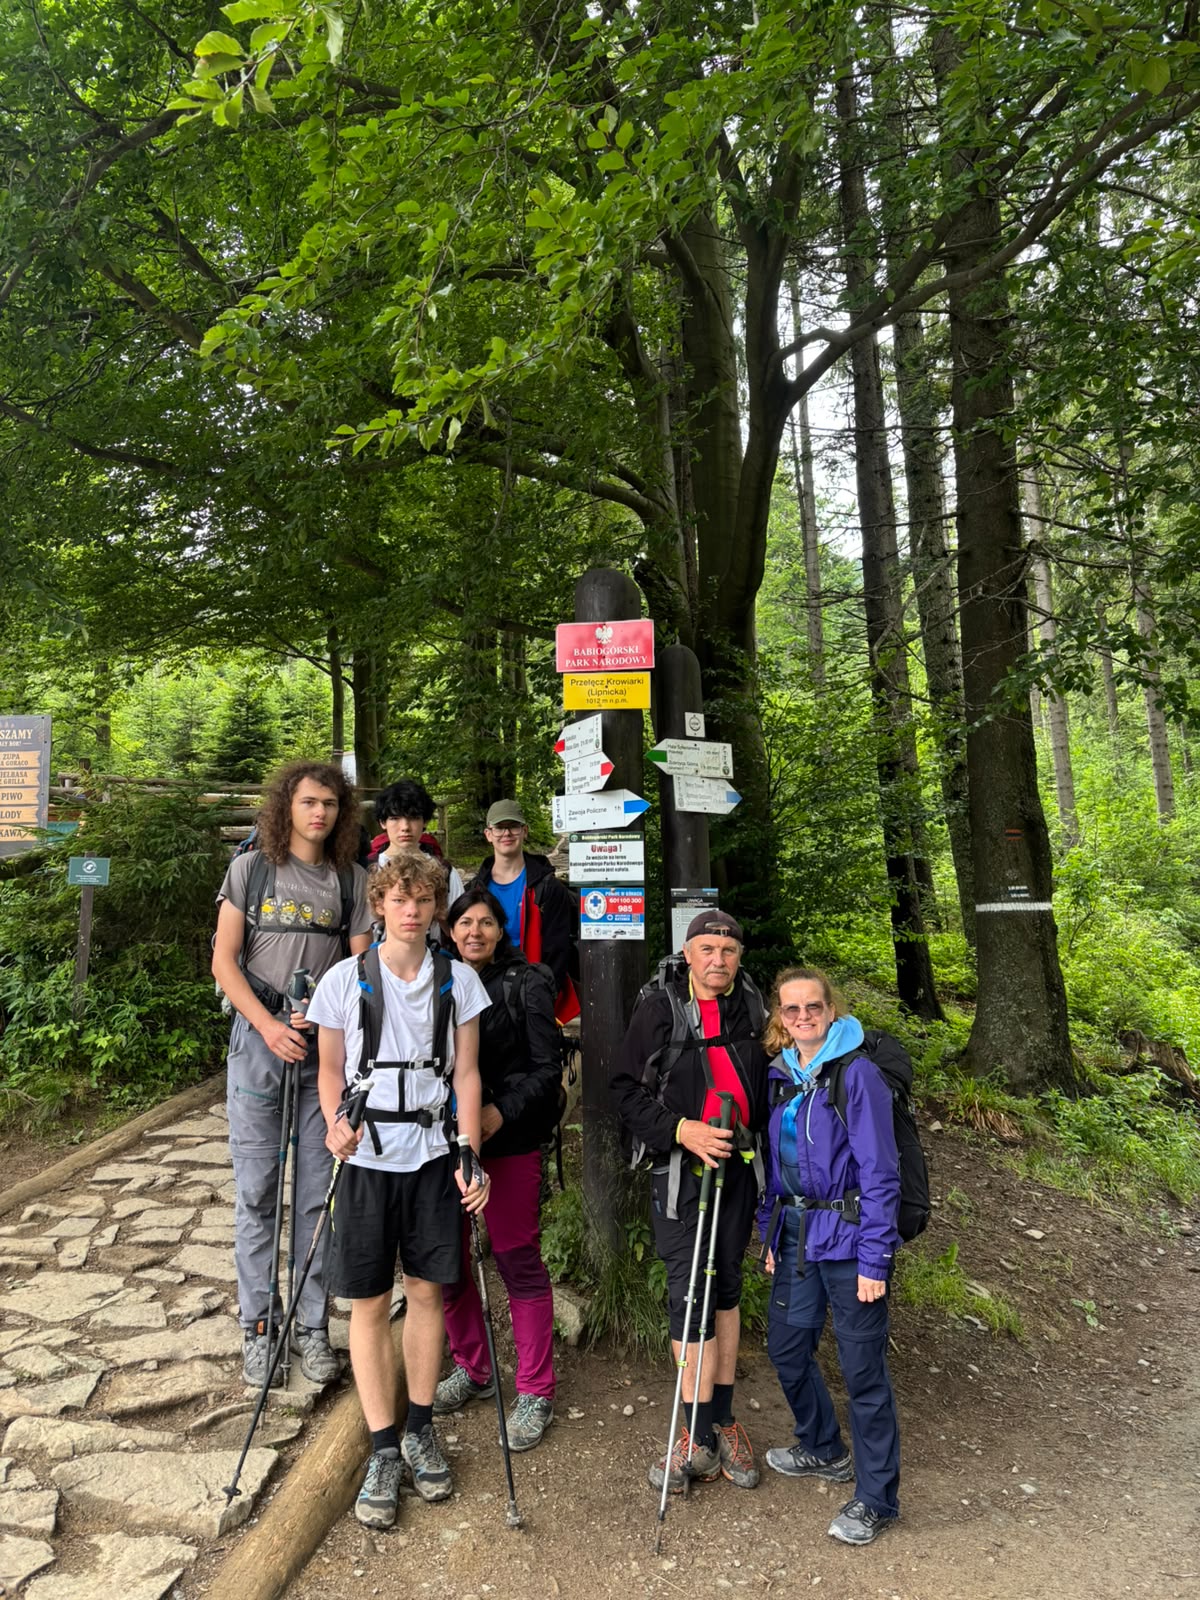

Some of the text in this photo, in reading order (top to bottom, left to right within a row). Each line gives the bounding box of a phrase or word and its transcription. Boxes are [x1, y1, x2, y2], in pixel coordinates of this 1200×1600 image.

[574, 646, 639, 656] BABIOGÓRSKI
[565, 656, 648, 668] PARK NARODOWY
[570, 677, 644, 687] Przełęcz Krowiarki
[588, 688, 627, 697] (Lipnicka)
[1, 792, 23, 800] PIWO
[591, 844, 618, 853] Uwaga
